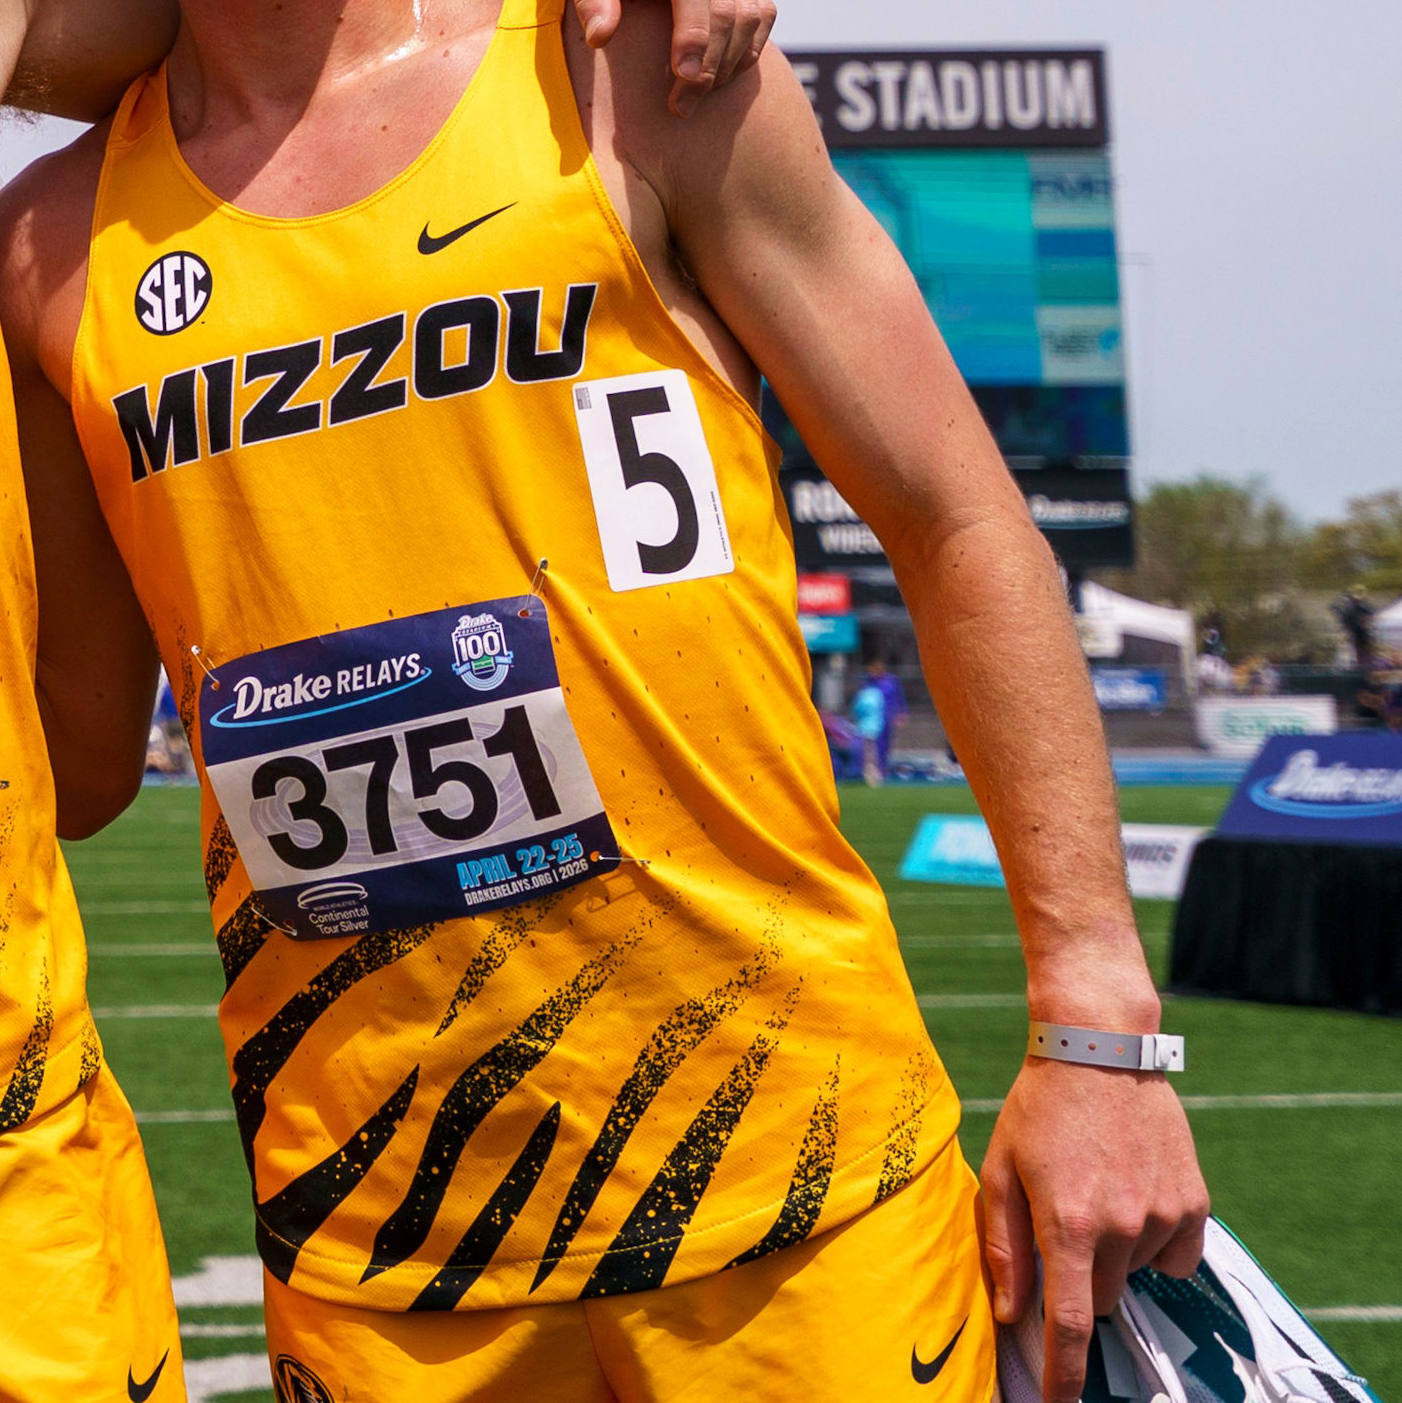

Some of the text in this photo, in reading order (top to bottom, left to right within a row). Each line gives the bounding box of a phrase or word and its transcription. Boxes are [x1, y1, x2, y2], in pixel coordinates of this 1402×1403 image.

[835, 59, 1096, 132] STADIUM
[138, 254, 208, 333] SEC
[112, 281, 599, 486] MIZZOU
[606, 386, 699, 575] 5
[458, 631, 501, 662] 100
[233, 673, 332, 719] Drake
[251, 705, 562, 871] 3751
[456, 833, 584, 890] APRIL 22-25
[464, 872, 553, 906] DRAKERELAYS.ORG
[558, 858, 589, 880] 2026
[308, 904, 369, 924] Continental
[316, 920, 369, 935] Tour Silver
